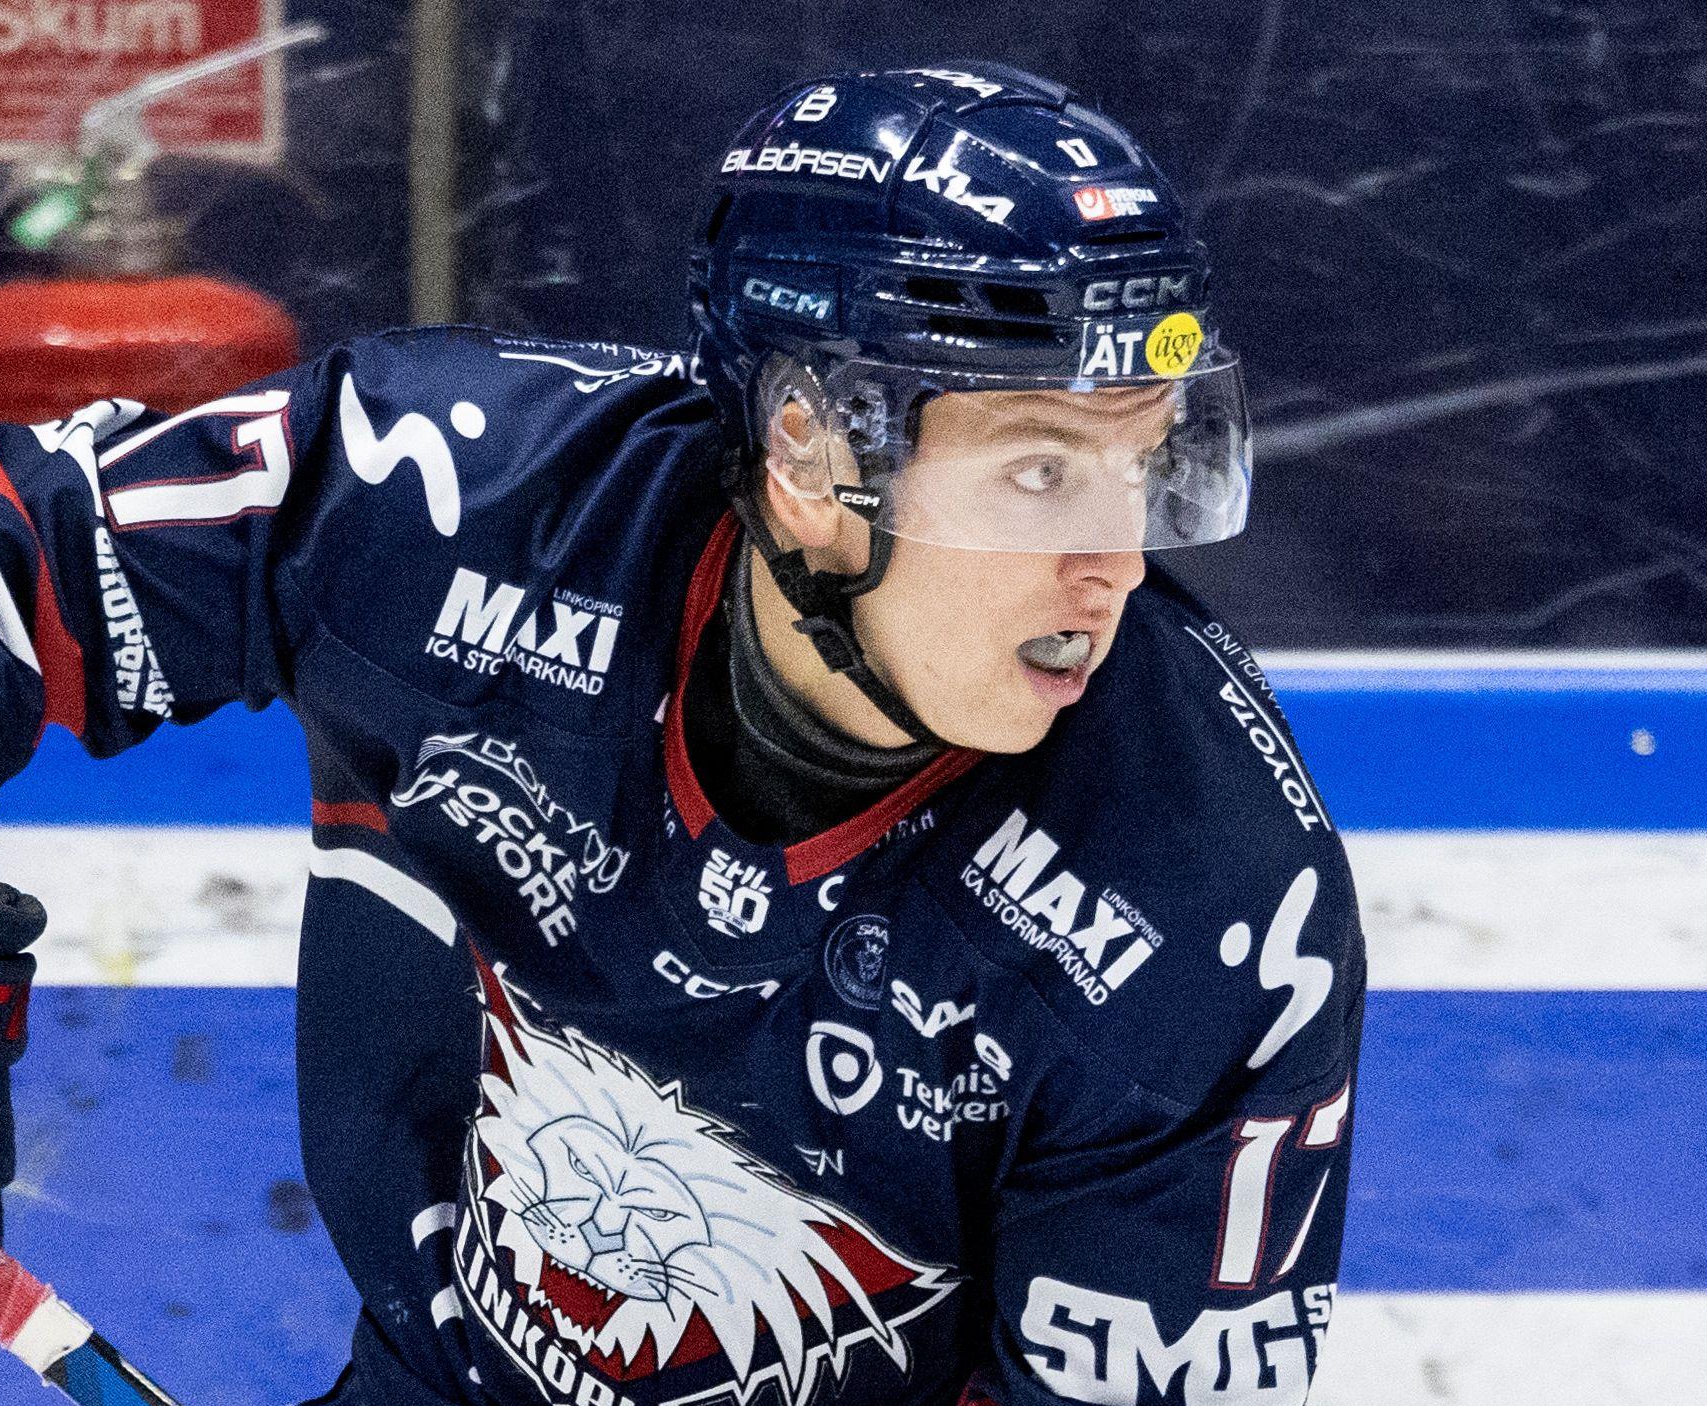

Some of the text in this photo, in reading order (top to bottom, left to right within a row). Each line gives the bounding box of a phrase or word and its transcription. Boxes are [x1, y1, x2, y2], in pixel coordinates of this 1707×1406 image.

[743, 278, 831, 320] CCM
[1083, 274, 1190, 311] CCM
[1083, 324, 1142, 376] ÄT
[838, 492, 880, 507] CCM
[433, 567, 621, 673] MAXI
[1219, 682, 1319, 831] TOYOTA
[440, 798, 577, 947] STORE
[959, 865, 984, 897] ICA
[972, 808, 1154, 991] MAXI
